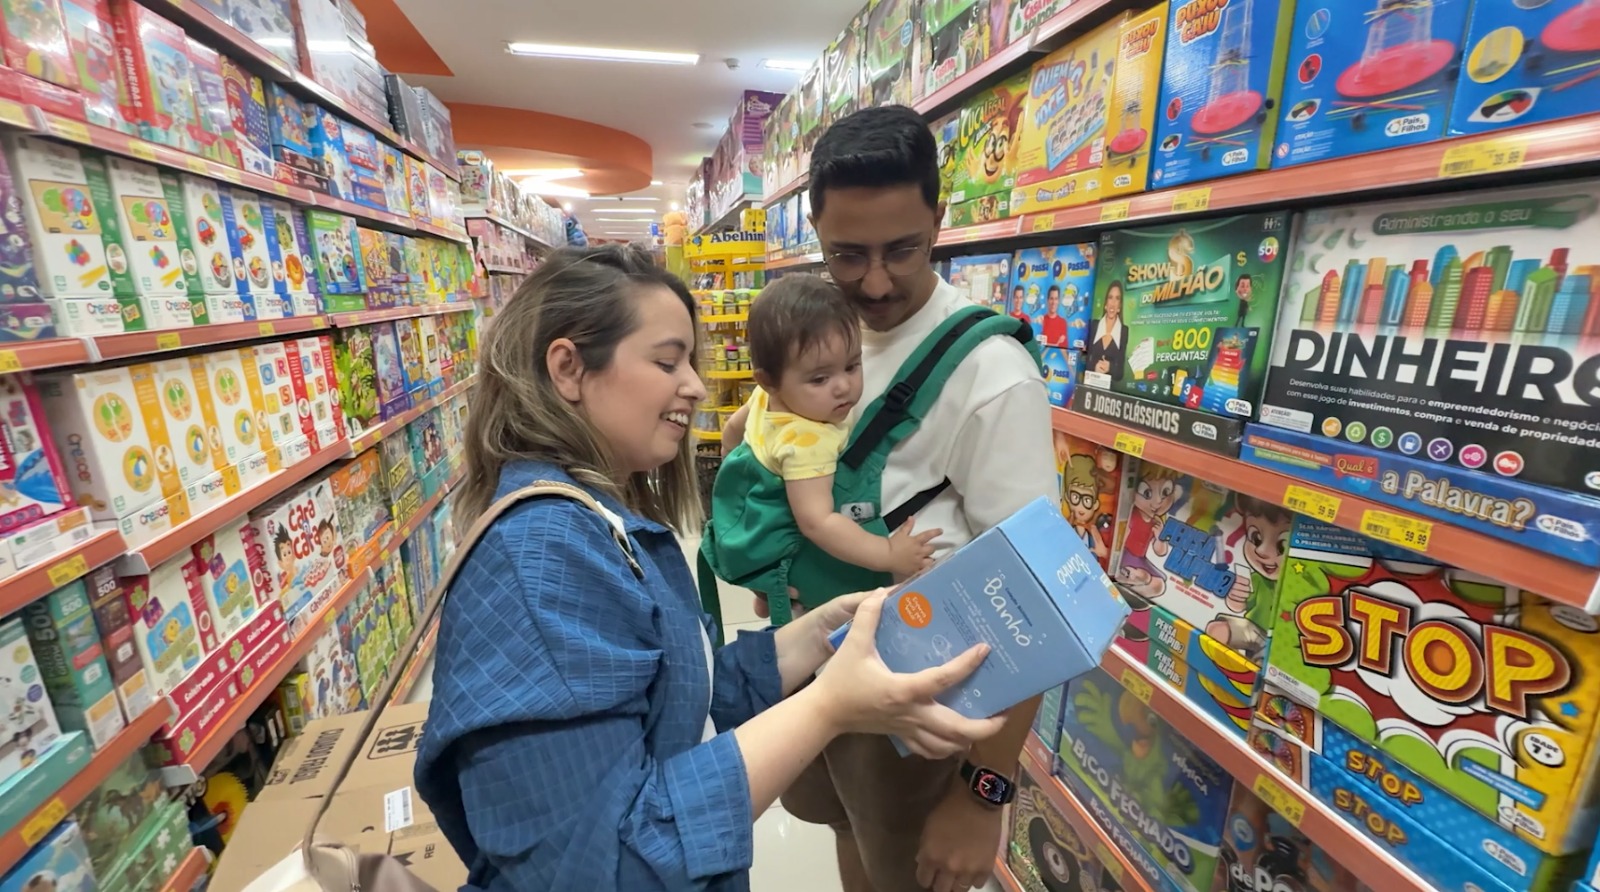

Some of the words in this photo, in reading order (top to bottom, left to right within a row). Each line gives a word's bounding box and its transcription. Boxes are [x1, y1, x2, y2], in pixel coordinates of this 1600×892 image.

[1400, 123, 1426, 133] Filhos
[1402, 116, 1419, 125] Pais
[1379, 211, 1478, 231] Administrando
[1484, 211, 1495, 223] o
[1500, 208, 1533, 222] seu
[1259, 241, 1278, 255] sbt
[1128, 263, 1171, 282] SHOW
[1152, 265, 1224, 303] MILHÃO
[1172, 327, 1211, 350] 800
[1156, 350, 1209, 363] PERGUNTAS!
[1084, 391, 1092, 410] 6
[1093, 394, 1121, 418] JOGOS
[1123, 400, 1180, 435] CLÁSSICOS
[1287, 389, 1302, 398] com
[1303, 393, 1319, 401] esse
[1319, 394, 1336, 404] jogo
[1337, 396, 1348, 406] de
[1348, 399, 1412, 417] investimentos,
[1414, 411, 1453, 425] compra
[1464, 418, 1499, 431] venda
[1501, 423, 1518, 434] de
[1289, 378, 1329, 391] Desenvolva
[1330, 385, 1348, 393] suas
[1348, 387, 1396, 401] habilidades
[1397, 394, 1418, 404] para
[1428, 400, 1540, 423] empreendedorismo
[1337, 458, 1364, 473] Qual
[1367, 462, 1373, 473] é
[1382, 470, 1399, 494] a
[1404, 470, 1536, 531] Palavra?
[289, 499, 316, 532] Cara
[293, 526, 321, 560] Cara
[97, 581, 117, 597] 500
[1155, 618, 1177, 638] PENSA
[1295, 592, 1571, 717] STOP
[1530, 736, 1559, 753] IDADE
[1347, 750, 1424, 808] STOP
[1071, 737, 1110, 789] BICO
[1109, 778, 1193, 871] FECHADO
[1334, 788, 1408, 847] STOP
